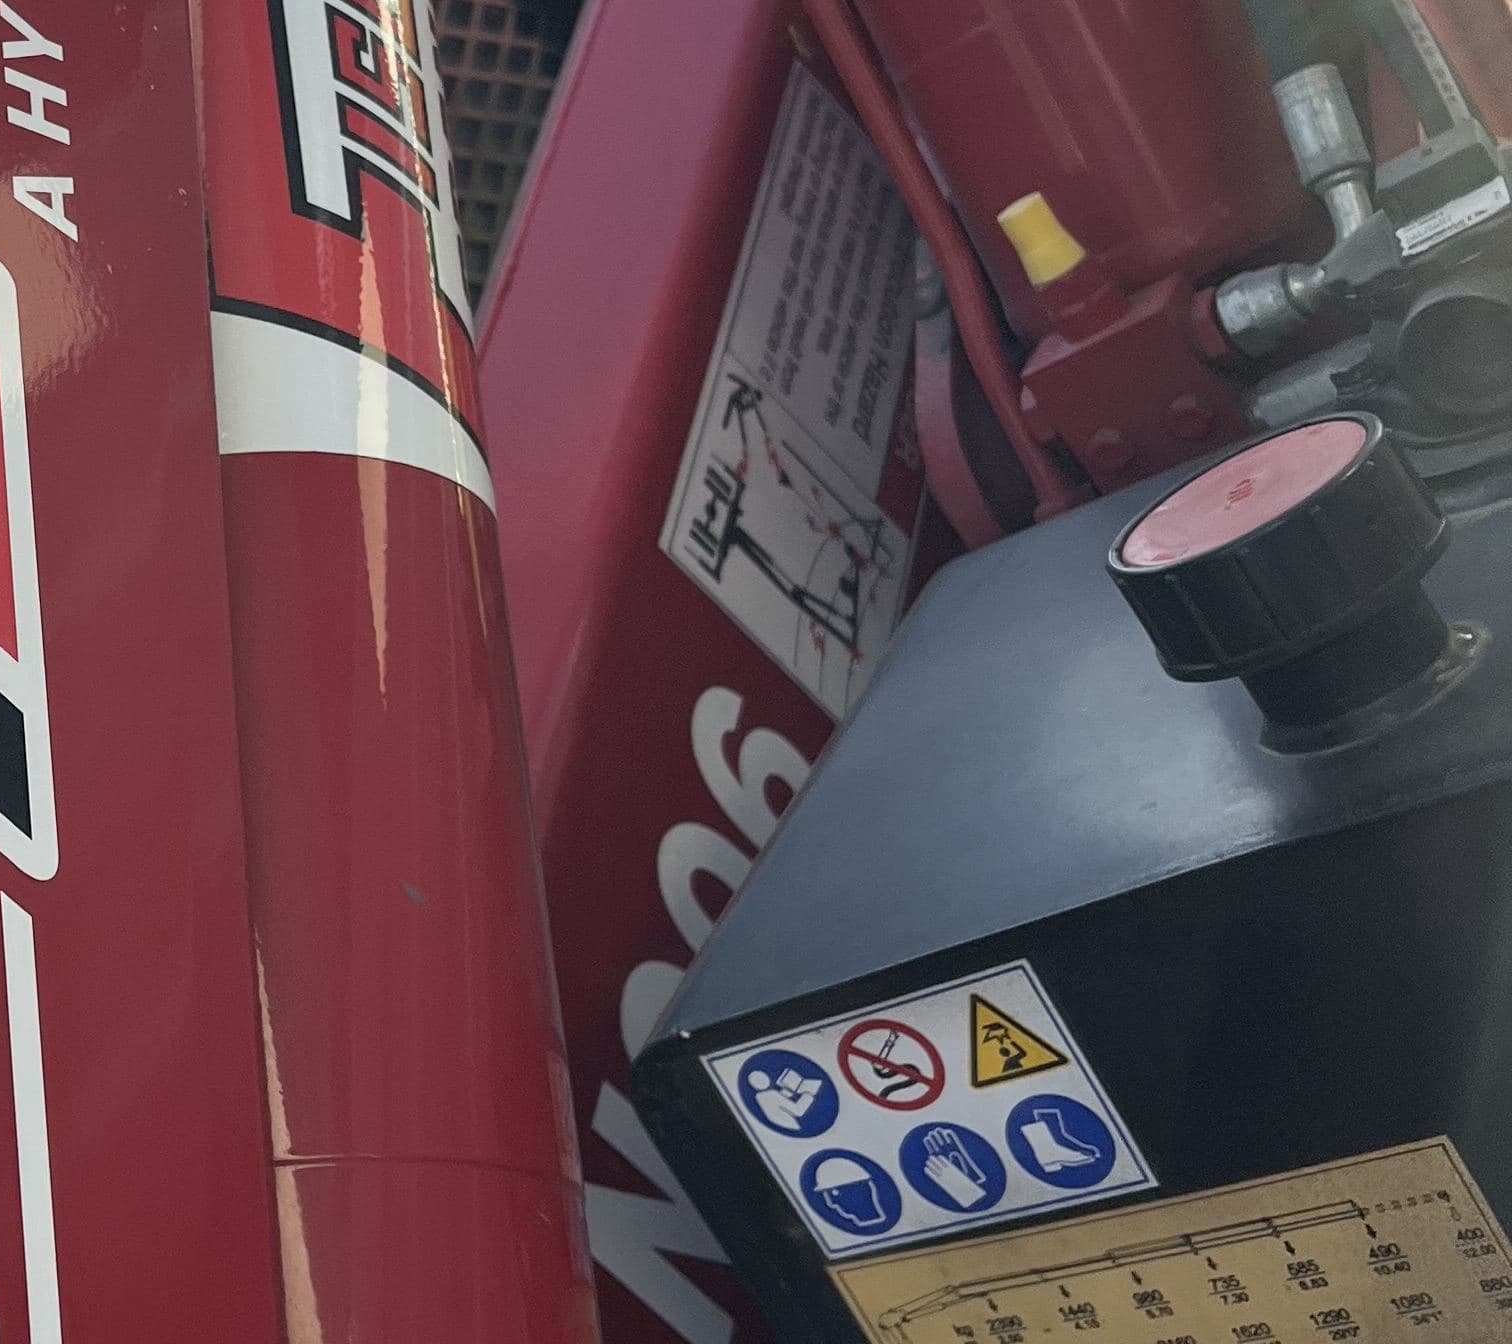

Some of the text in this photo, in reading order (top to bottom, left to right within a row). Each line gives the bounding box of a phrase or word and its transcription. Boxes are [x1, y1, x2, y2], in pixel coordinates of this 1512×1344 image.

[13, 174, 78, 243] A
[1208, 1275, 1240, 1292] 735
[1286, 1258, 1321, 1276] 585
